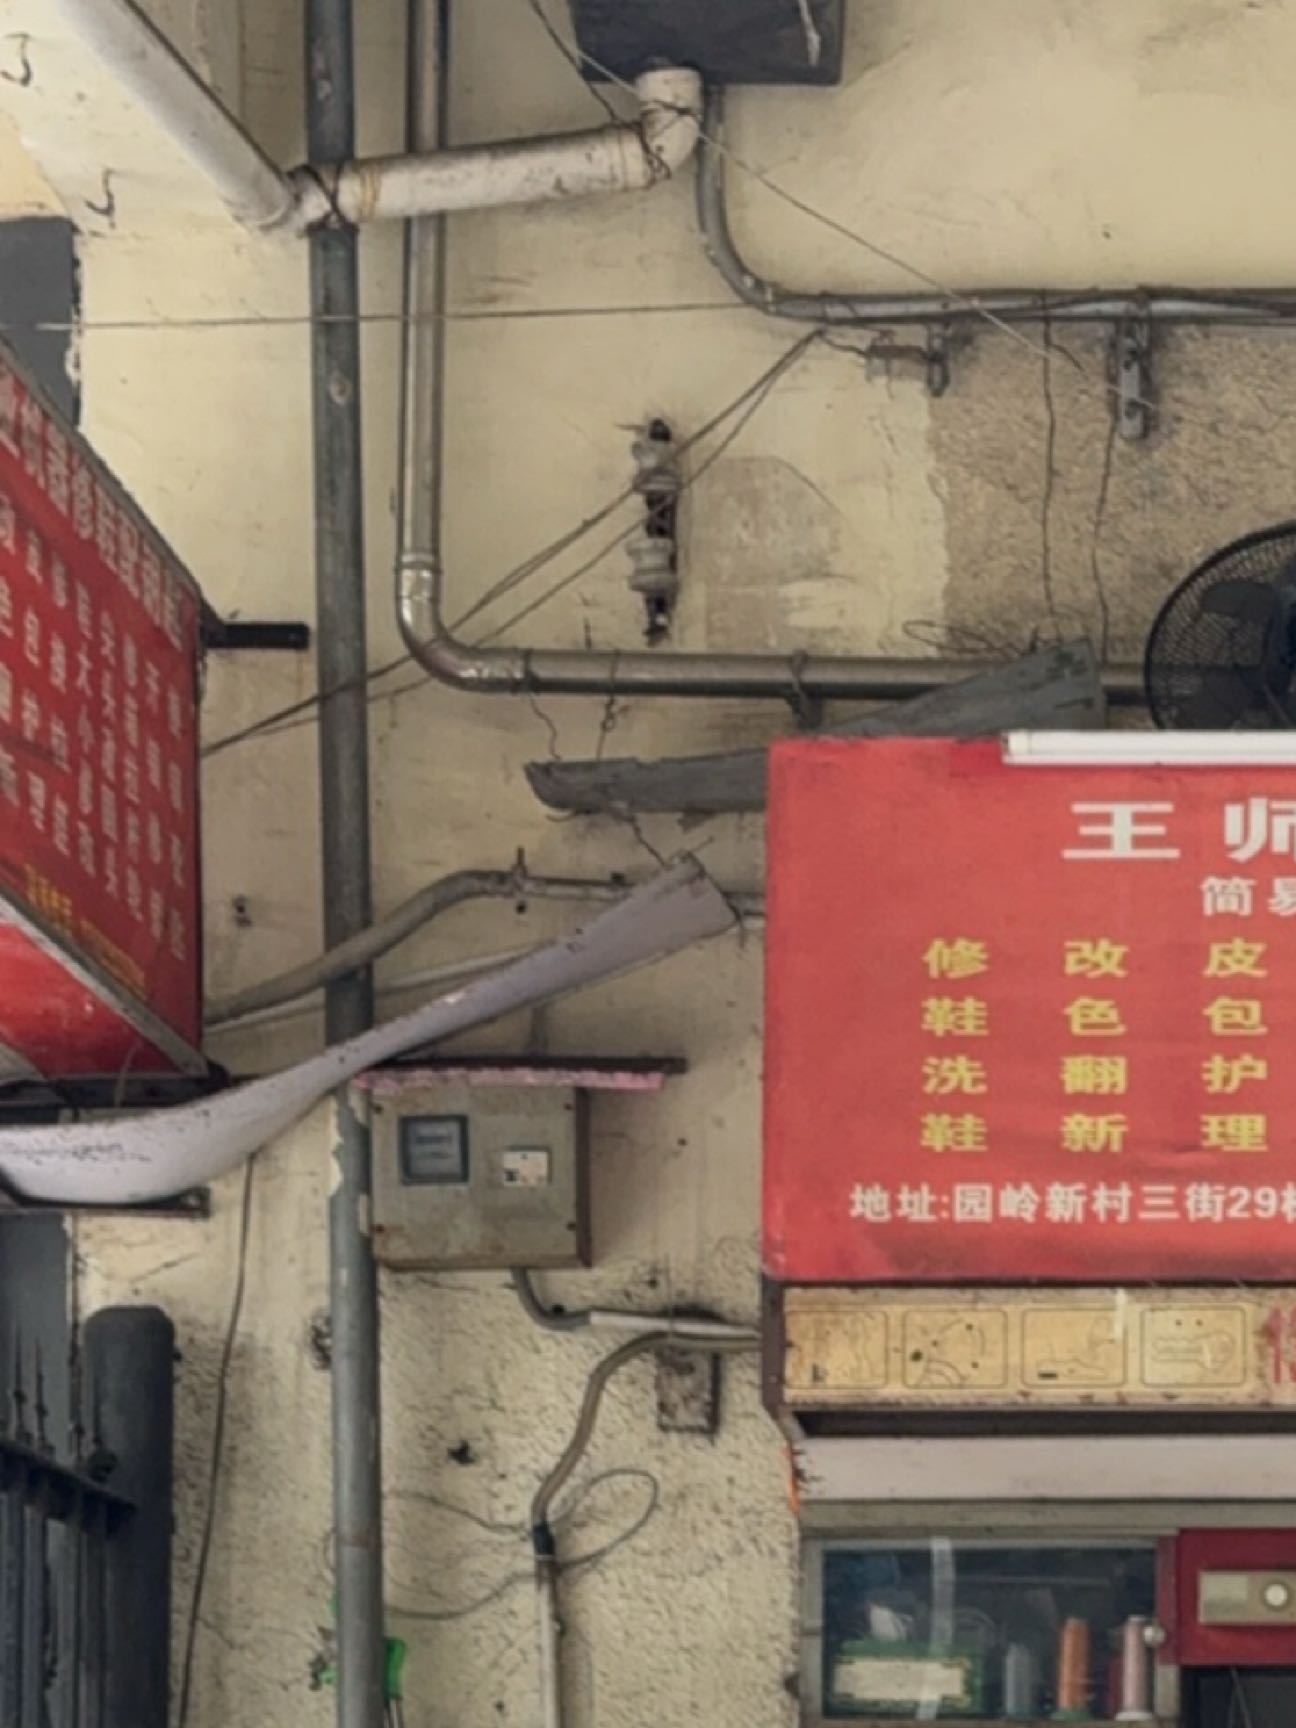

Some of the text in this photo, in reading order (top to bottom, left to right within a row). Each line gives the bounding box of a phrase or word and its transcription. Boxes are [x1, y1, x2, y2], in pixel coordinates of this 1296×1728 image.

[921, 938, 990, 1153] 修鞋洗鞋
[1060, 938, 1129, 1153] 改色翻新
[1200, 938, 1269, 1153] 皮包护理
